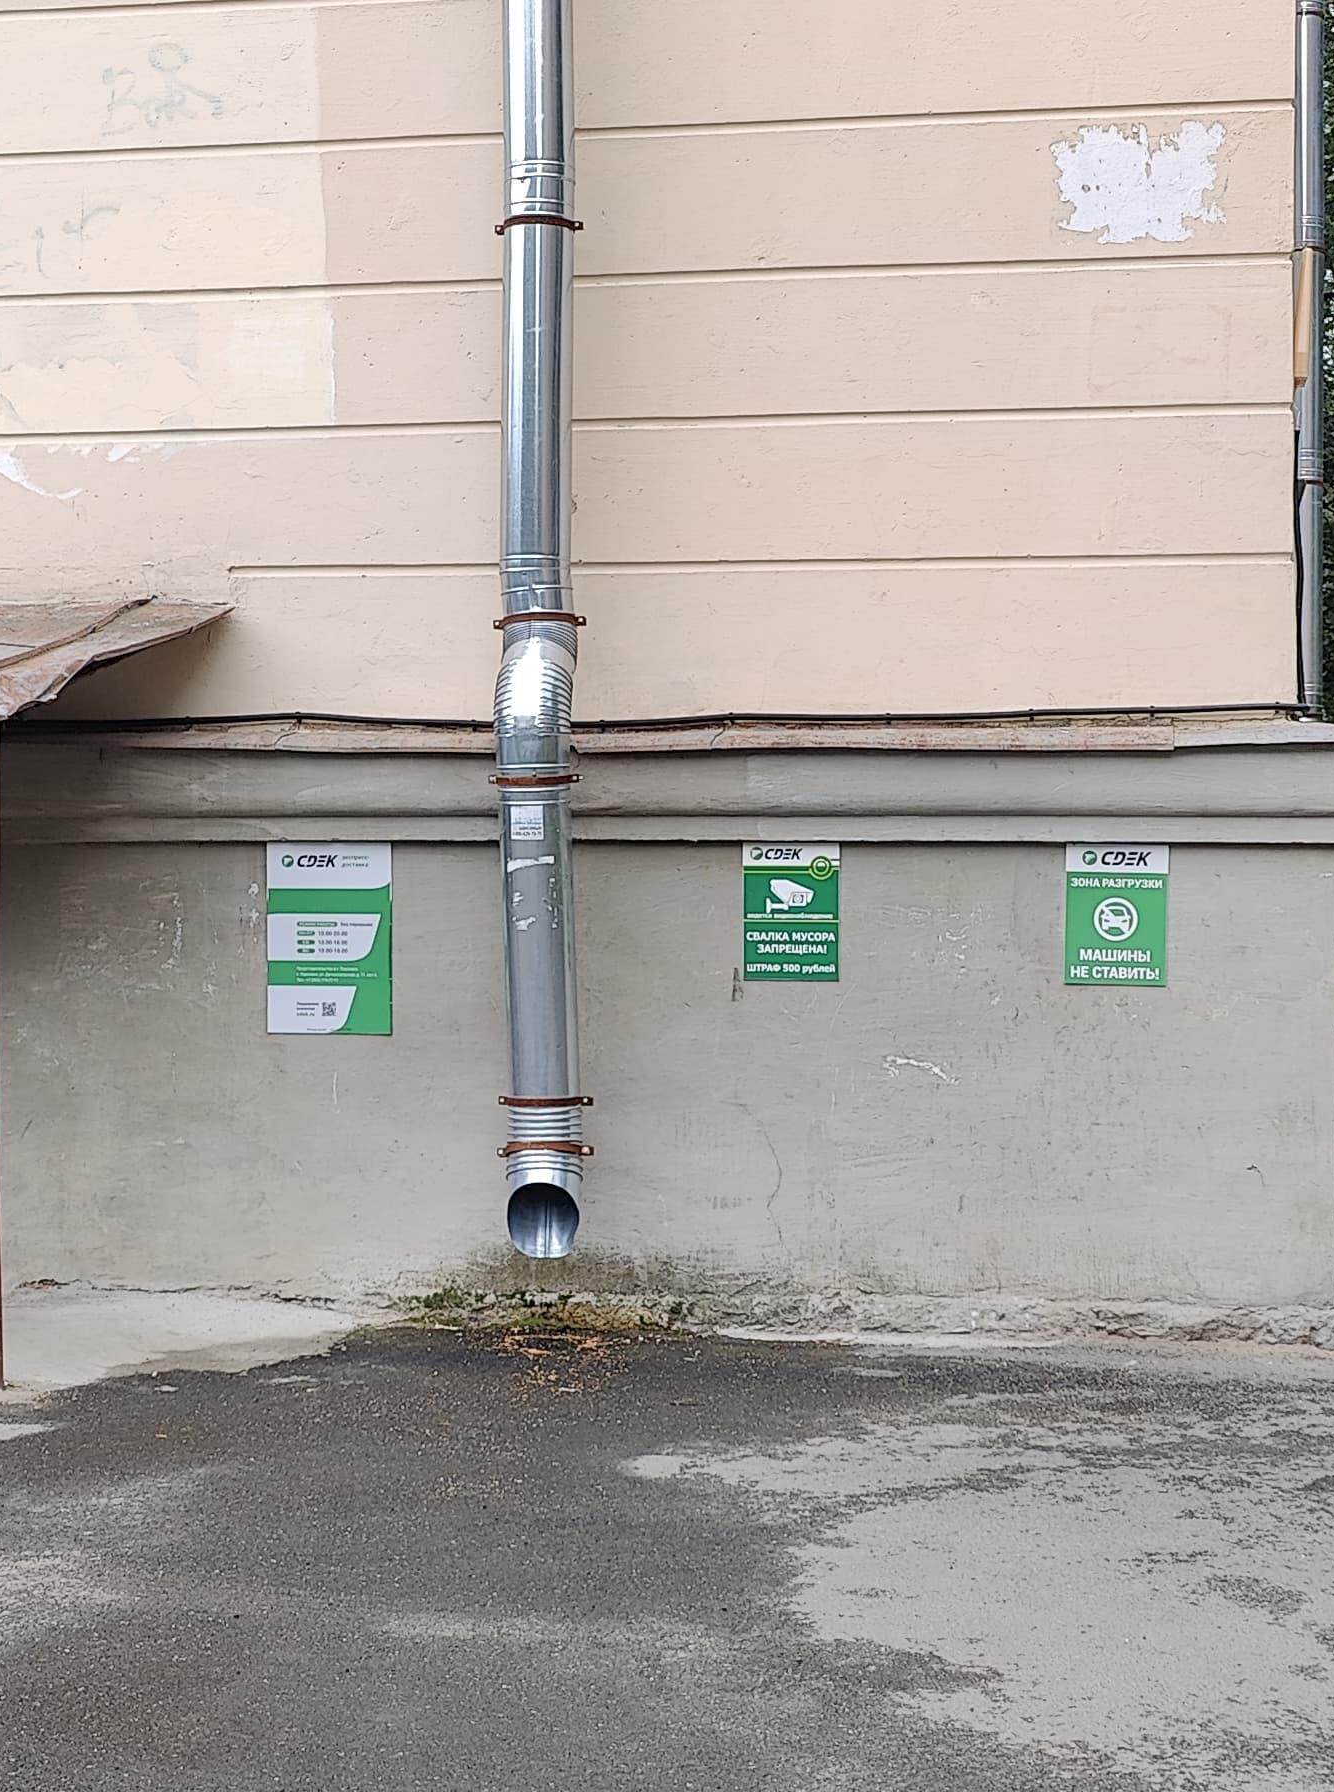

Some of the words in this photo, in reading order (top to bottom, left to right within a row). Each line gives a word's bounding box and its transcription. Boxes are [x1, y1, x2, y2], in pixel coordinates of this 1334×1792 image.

[764, 848, 803, 860] CDEK
[1101, 851, 1152, 866] CDEK
[297, 854, 338, 868] CDEK
[1070, 877, 1100, 888] ЗОНА
[1102, 878, 1163, 889] РАЗГРУЗКИ
[746, 931, 790, 941] СВАЛКА
[792, 932, 836, 942] МУСОРА
[757, 944, 827, 956] ЗАПРЕЩЕНА!
[1079, 949, 1151, 963] МАШИНЫ
[747, 963, 781, 973] ШТРАФ
[782, 963, 801, 973] 500
[802, 963, 836, 974] рублей
[1070, 965, 1089, 978] НЕ
[1092, 966, 1160, 980] СТАВИТЬ!
